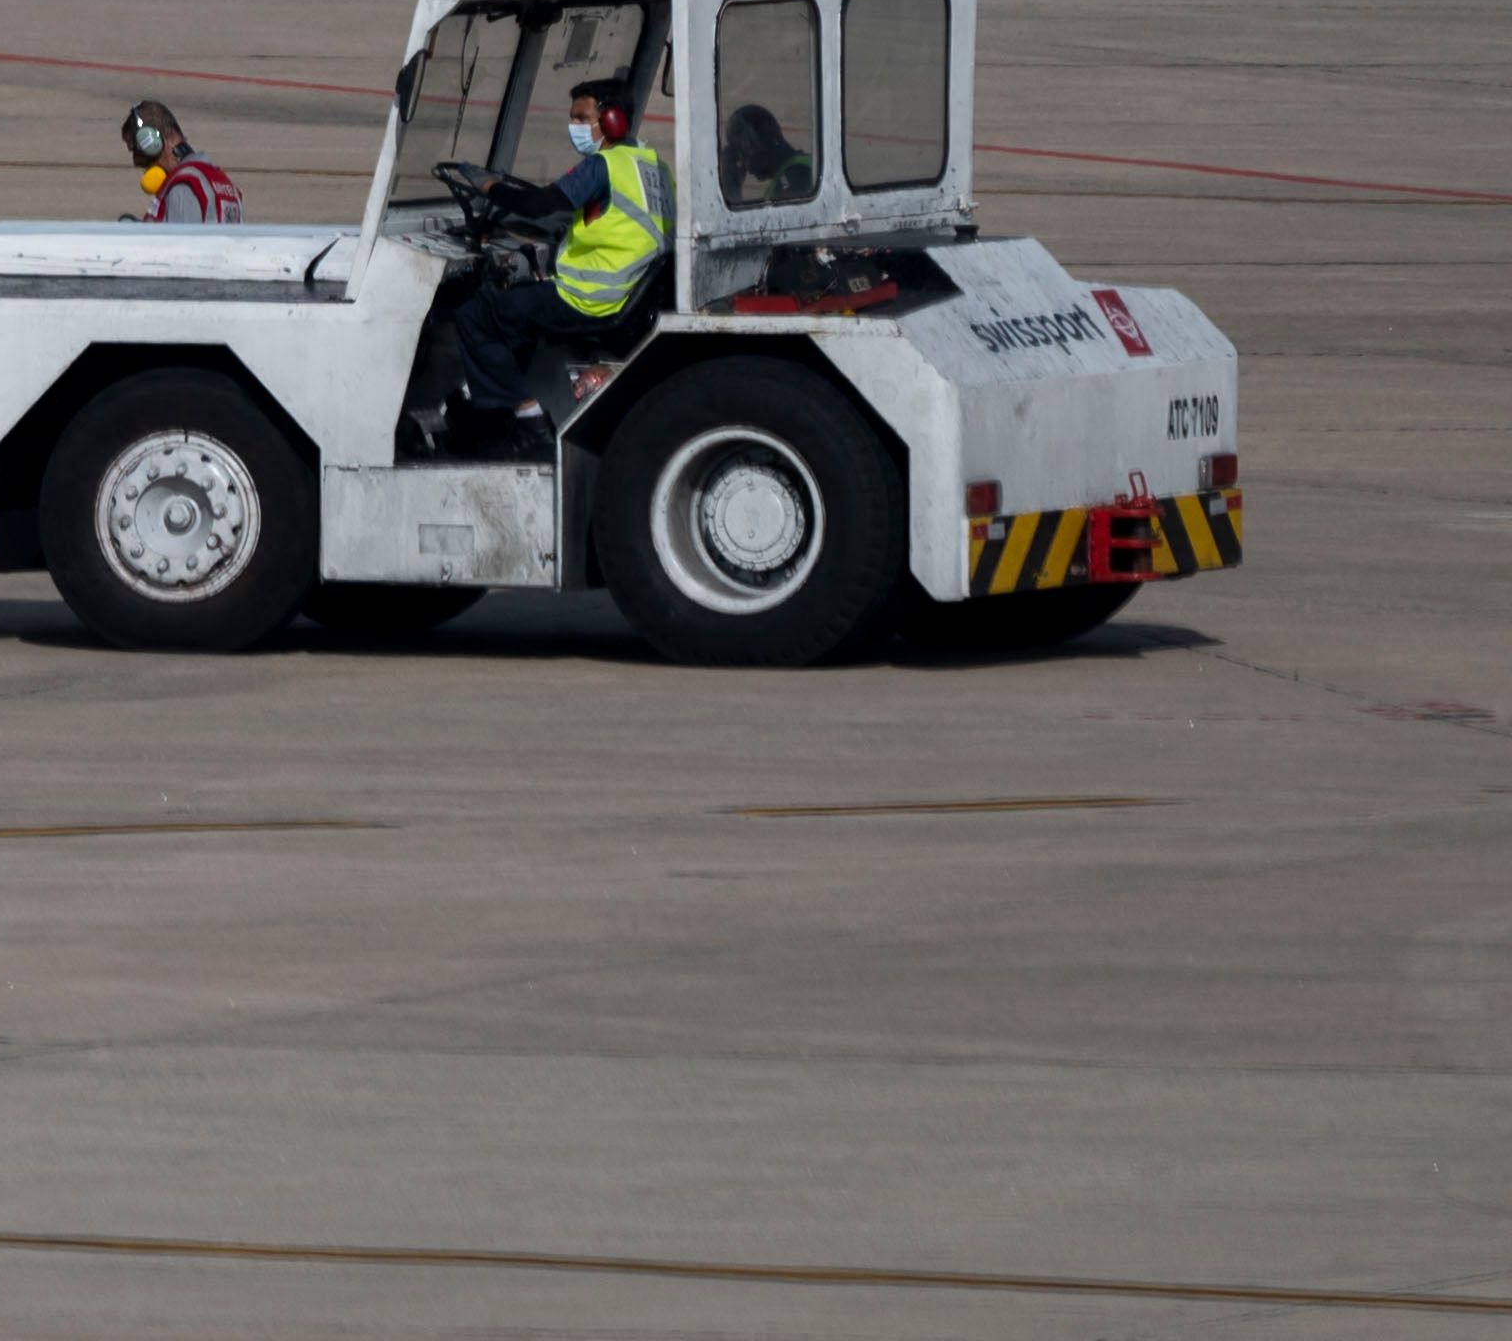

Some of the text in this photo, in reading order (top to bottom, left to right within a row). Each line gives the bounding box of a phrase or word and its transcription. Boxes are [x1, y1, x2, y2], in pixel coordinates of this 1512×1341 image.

[970, 304, 1107, 356] swissport
[1167, 394, 1219, 441] ATC 7109
